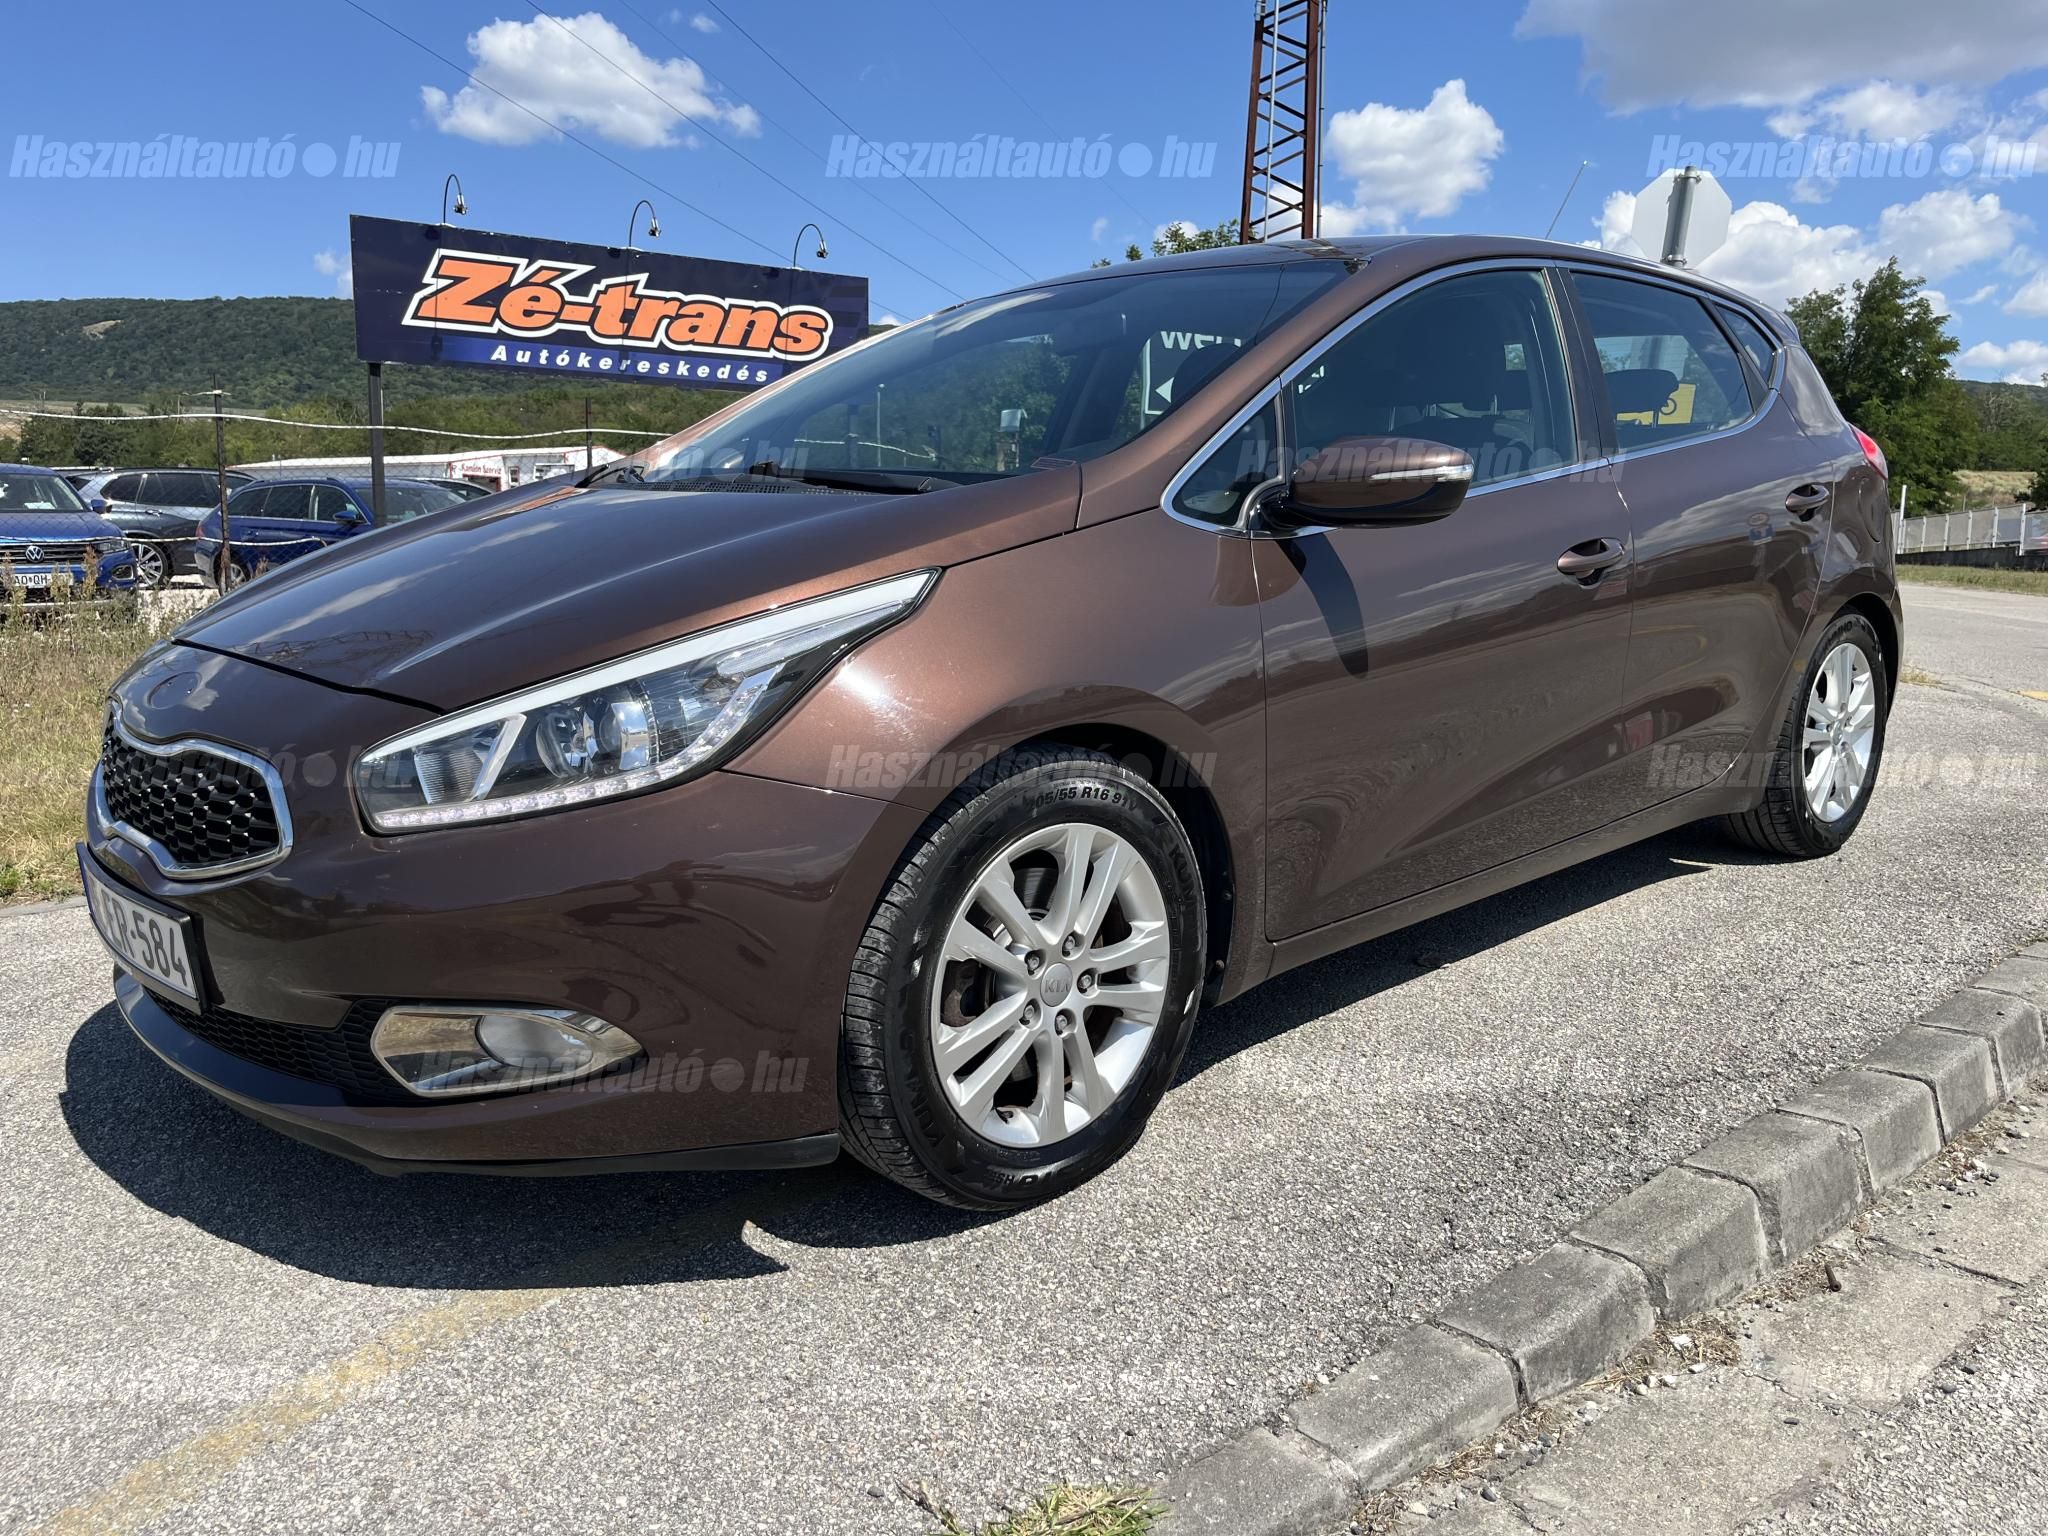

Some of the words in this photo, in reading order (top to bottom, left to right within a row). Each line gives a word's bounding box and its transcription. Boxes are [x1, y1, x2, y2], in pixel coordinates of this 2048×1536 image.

[403, 249, 834, 361] Zé-trans
[490, 344, 769, 384] Autókereskedés
[1080, 786, 1111, 801] R16
